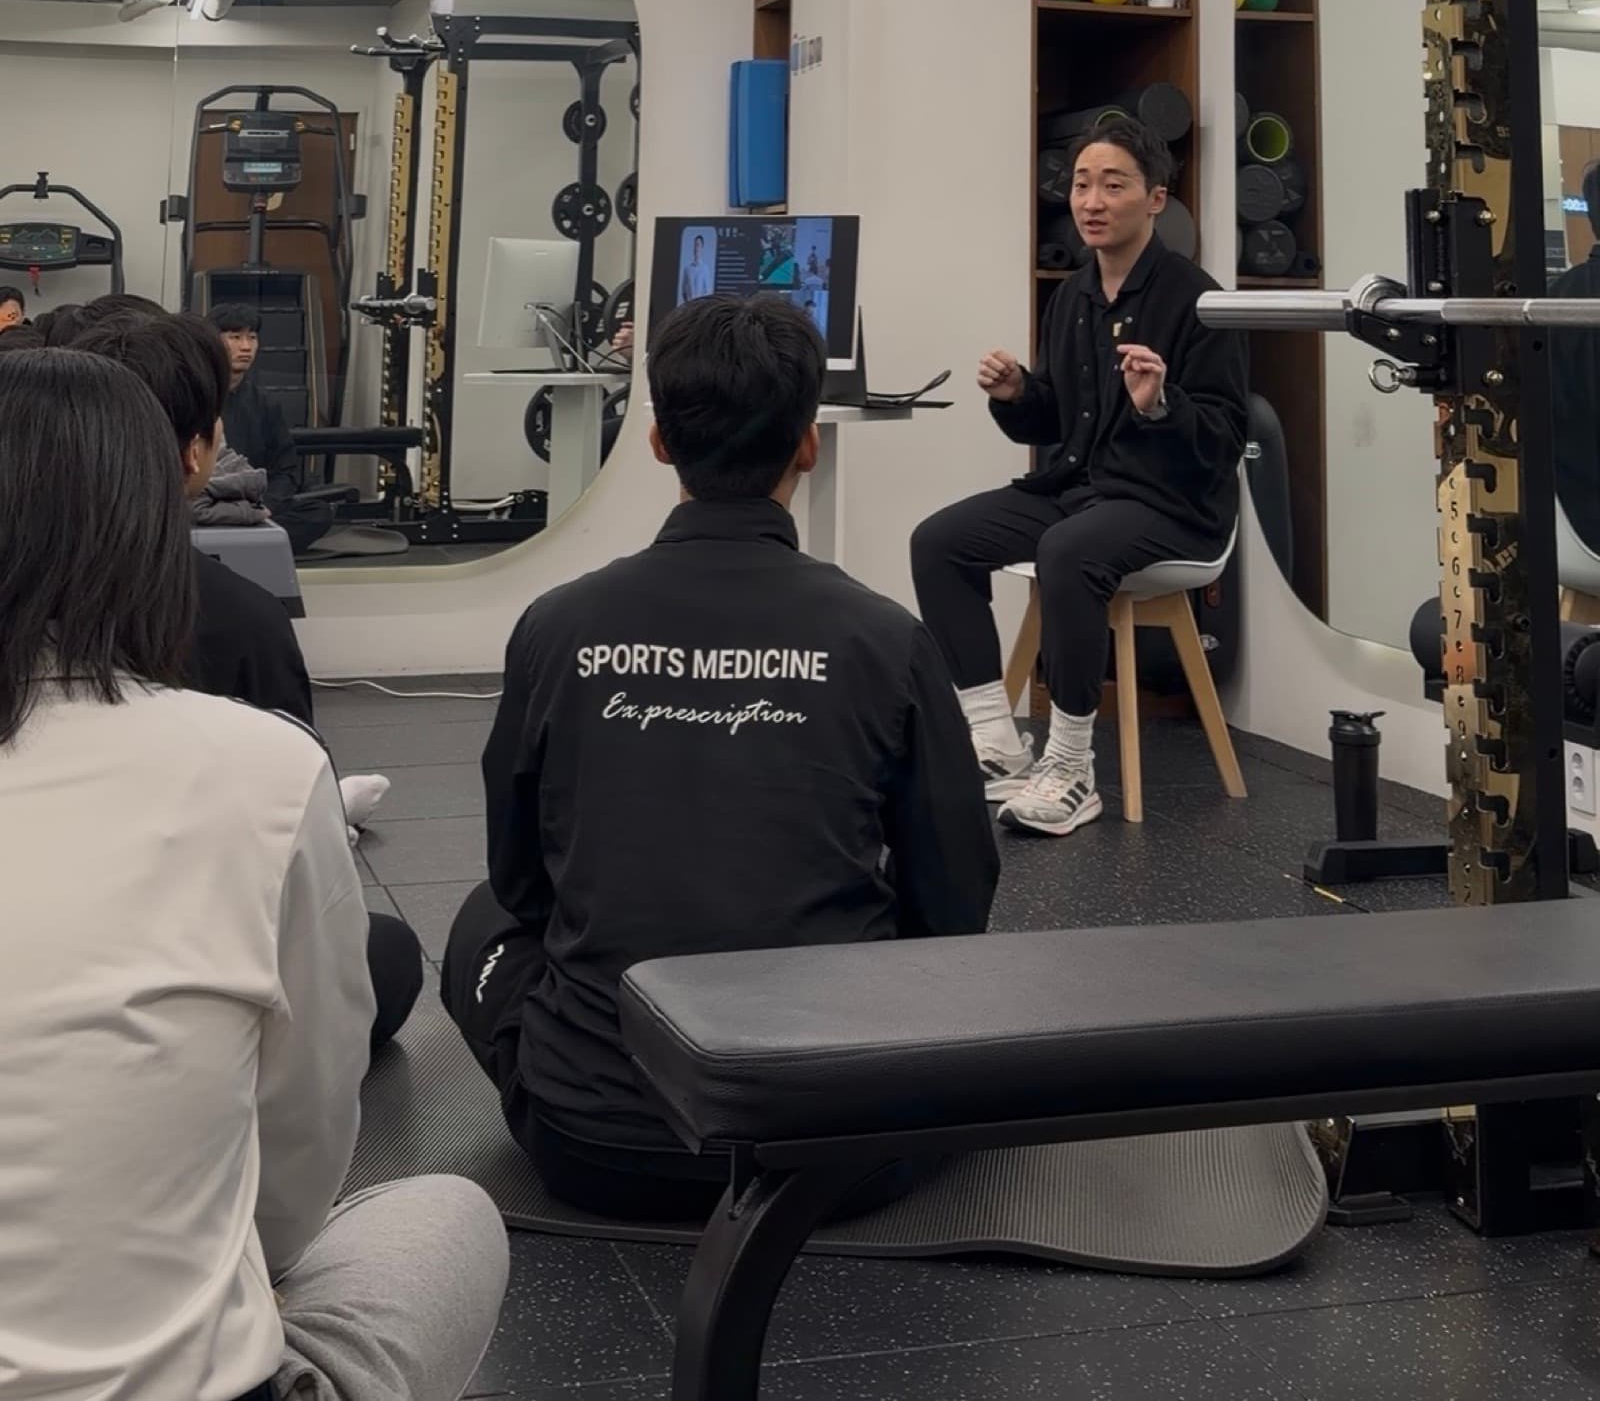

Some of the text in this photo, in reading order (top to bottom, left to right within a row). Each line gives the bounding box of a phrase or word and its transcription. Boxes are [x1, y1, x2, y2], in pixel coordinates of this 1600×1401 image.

[1450, 501, 1459, 520] 5
[1452, 556, 1460, 576] 6
[1454, 610, 1462, 629] 7
[577, 643, 829, 682] SPORTS MEDICINE
